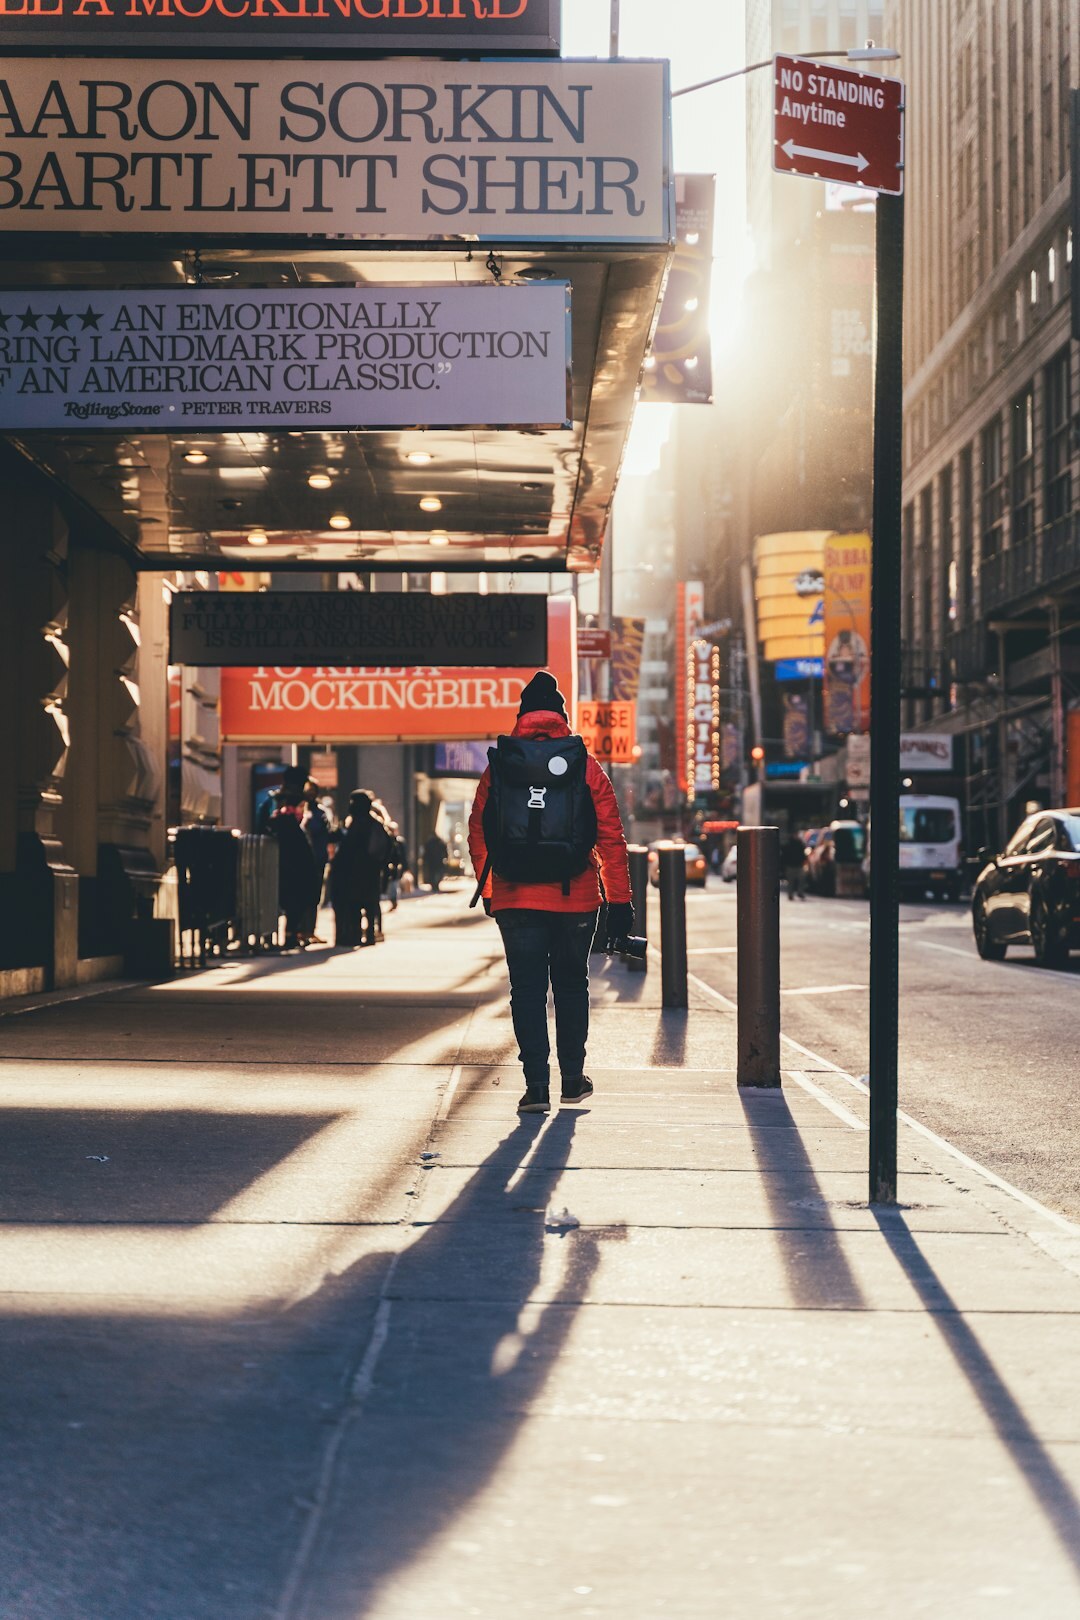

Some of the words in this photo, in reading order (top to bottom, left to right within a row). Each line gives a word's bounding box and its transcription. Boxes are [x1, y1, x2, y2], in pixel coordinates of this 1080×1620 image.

[781, 68, 803, 92] NO
[807, 74, 884, 109] STANDING
[0, 80, 260, 141] AARON
[279, 81, 593, 144] SORKIN
[781, 96, 846, 128] Anytime
[422, 153, 646, 217] SHER
[110, 304, 167, 331] AN
[176, 301, 442, 331] EMOTIONALLY
[89, 333, 307, 363] LANDMARK
[315, 331, 551, 360] PRODUCTION
[16, 366, 71, 394] AN
[78, 364, 275, 394] AMERICAN
[283, 361, 452, 392] CLASSIC.”
[181, 401, 243, 415] PETER
[246, 400, 332, 414] TRAVERS
[287, 596, 362, 613] AARON
[474, 597, 526, 614] PLAY
[182, 613, 250, 631] FULLY
[254, 614, 426, 631] DEMONSTRATES
[431, 614, 480, 631] WHY
[485, 614, 536, 631] THIS
[204, 631, 225, 648] IS
[228, 631, 289, 648] STILL
[292, 631, 308, 648] A
[311, 631, 440, 648] NECESSARY
[248, 678, 526, 710] MOCKINGBIRD
[581, 709, 629, 729] RAISE
[582, 736, 630, 755] PLOW
